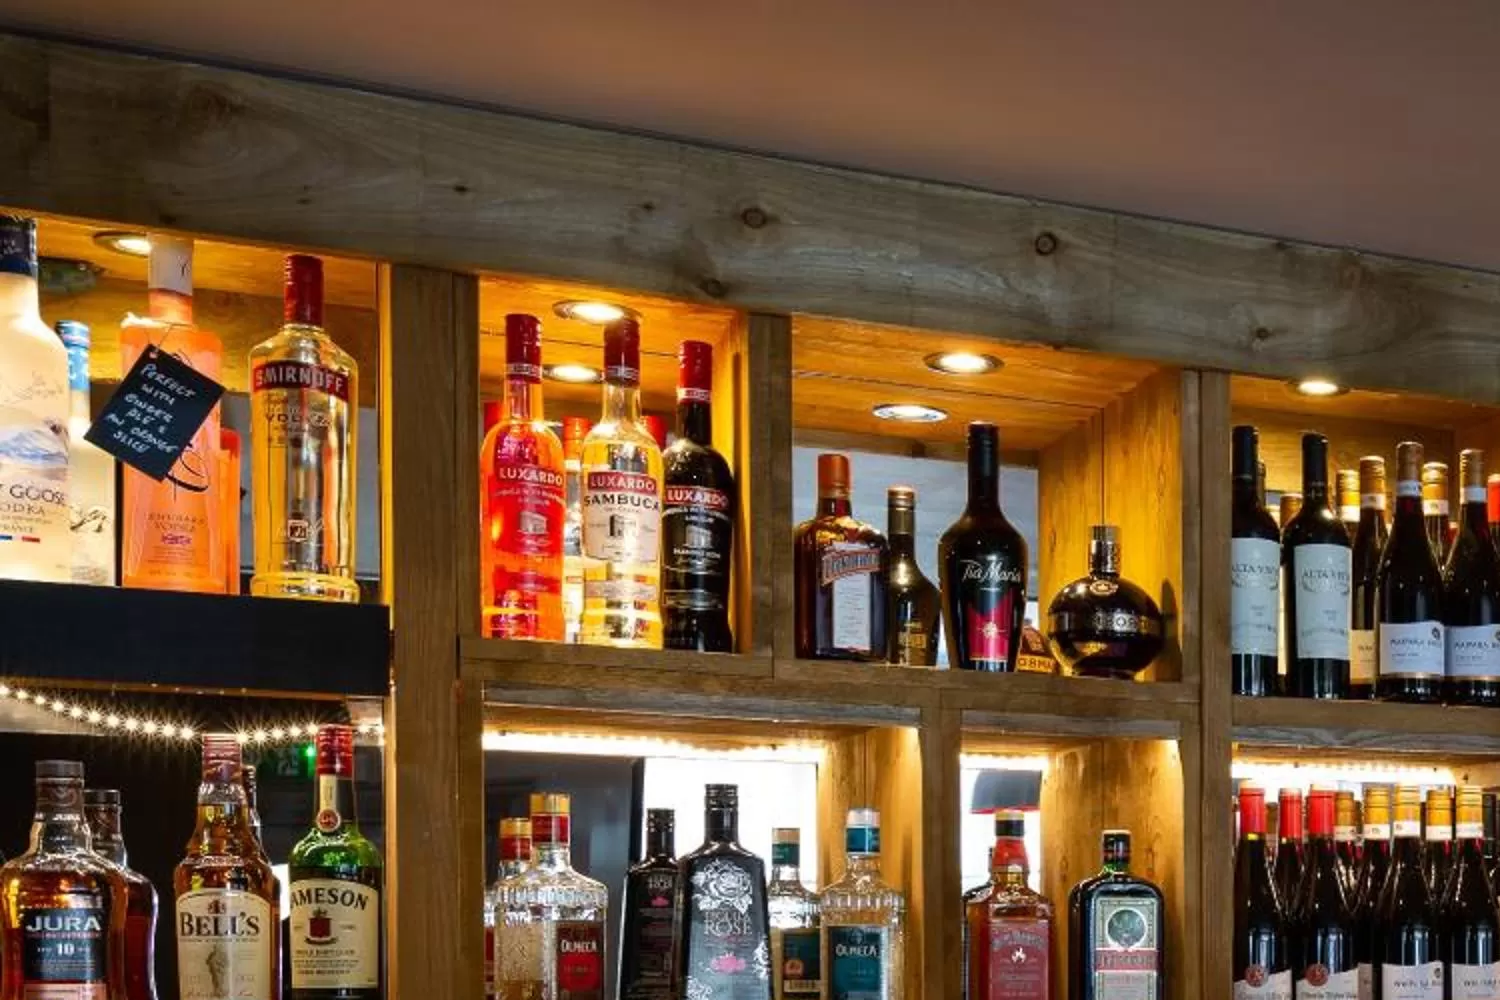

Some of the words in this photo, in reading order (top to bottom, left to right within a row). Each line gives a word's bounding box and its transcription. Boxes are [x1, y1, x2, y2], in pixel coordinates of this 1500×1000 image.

[255, 366, 343, 393] SMIRNOFF
[500, 467, 562, 486] LUXARDO
[590, 474, 655, 491] LUXARDO
[584, 493, 659, 510] SAMBUCA
[667, 489, 728, 506] LUXARDO
[0, 502, 46, 516] ODKA
[289, 887, 370, 912] AMESON
[26, 916, 101, 931] JURA
[180, 912, 260, 937] BELL'S
[703, 920, 753, 937] ROSE
[57, 943, 74, 956] 10
[561, 939, 597, 953] OLMECA
[835, 943, 878, 957] OLMECA
